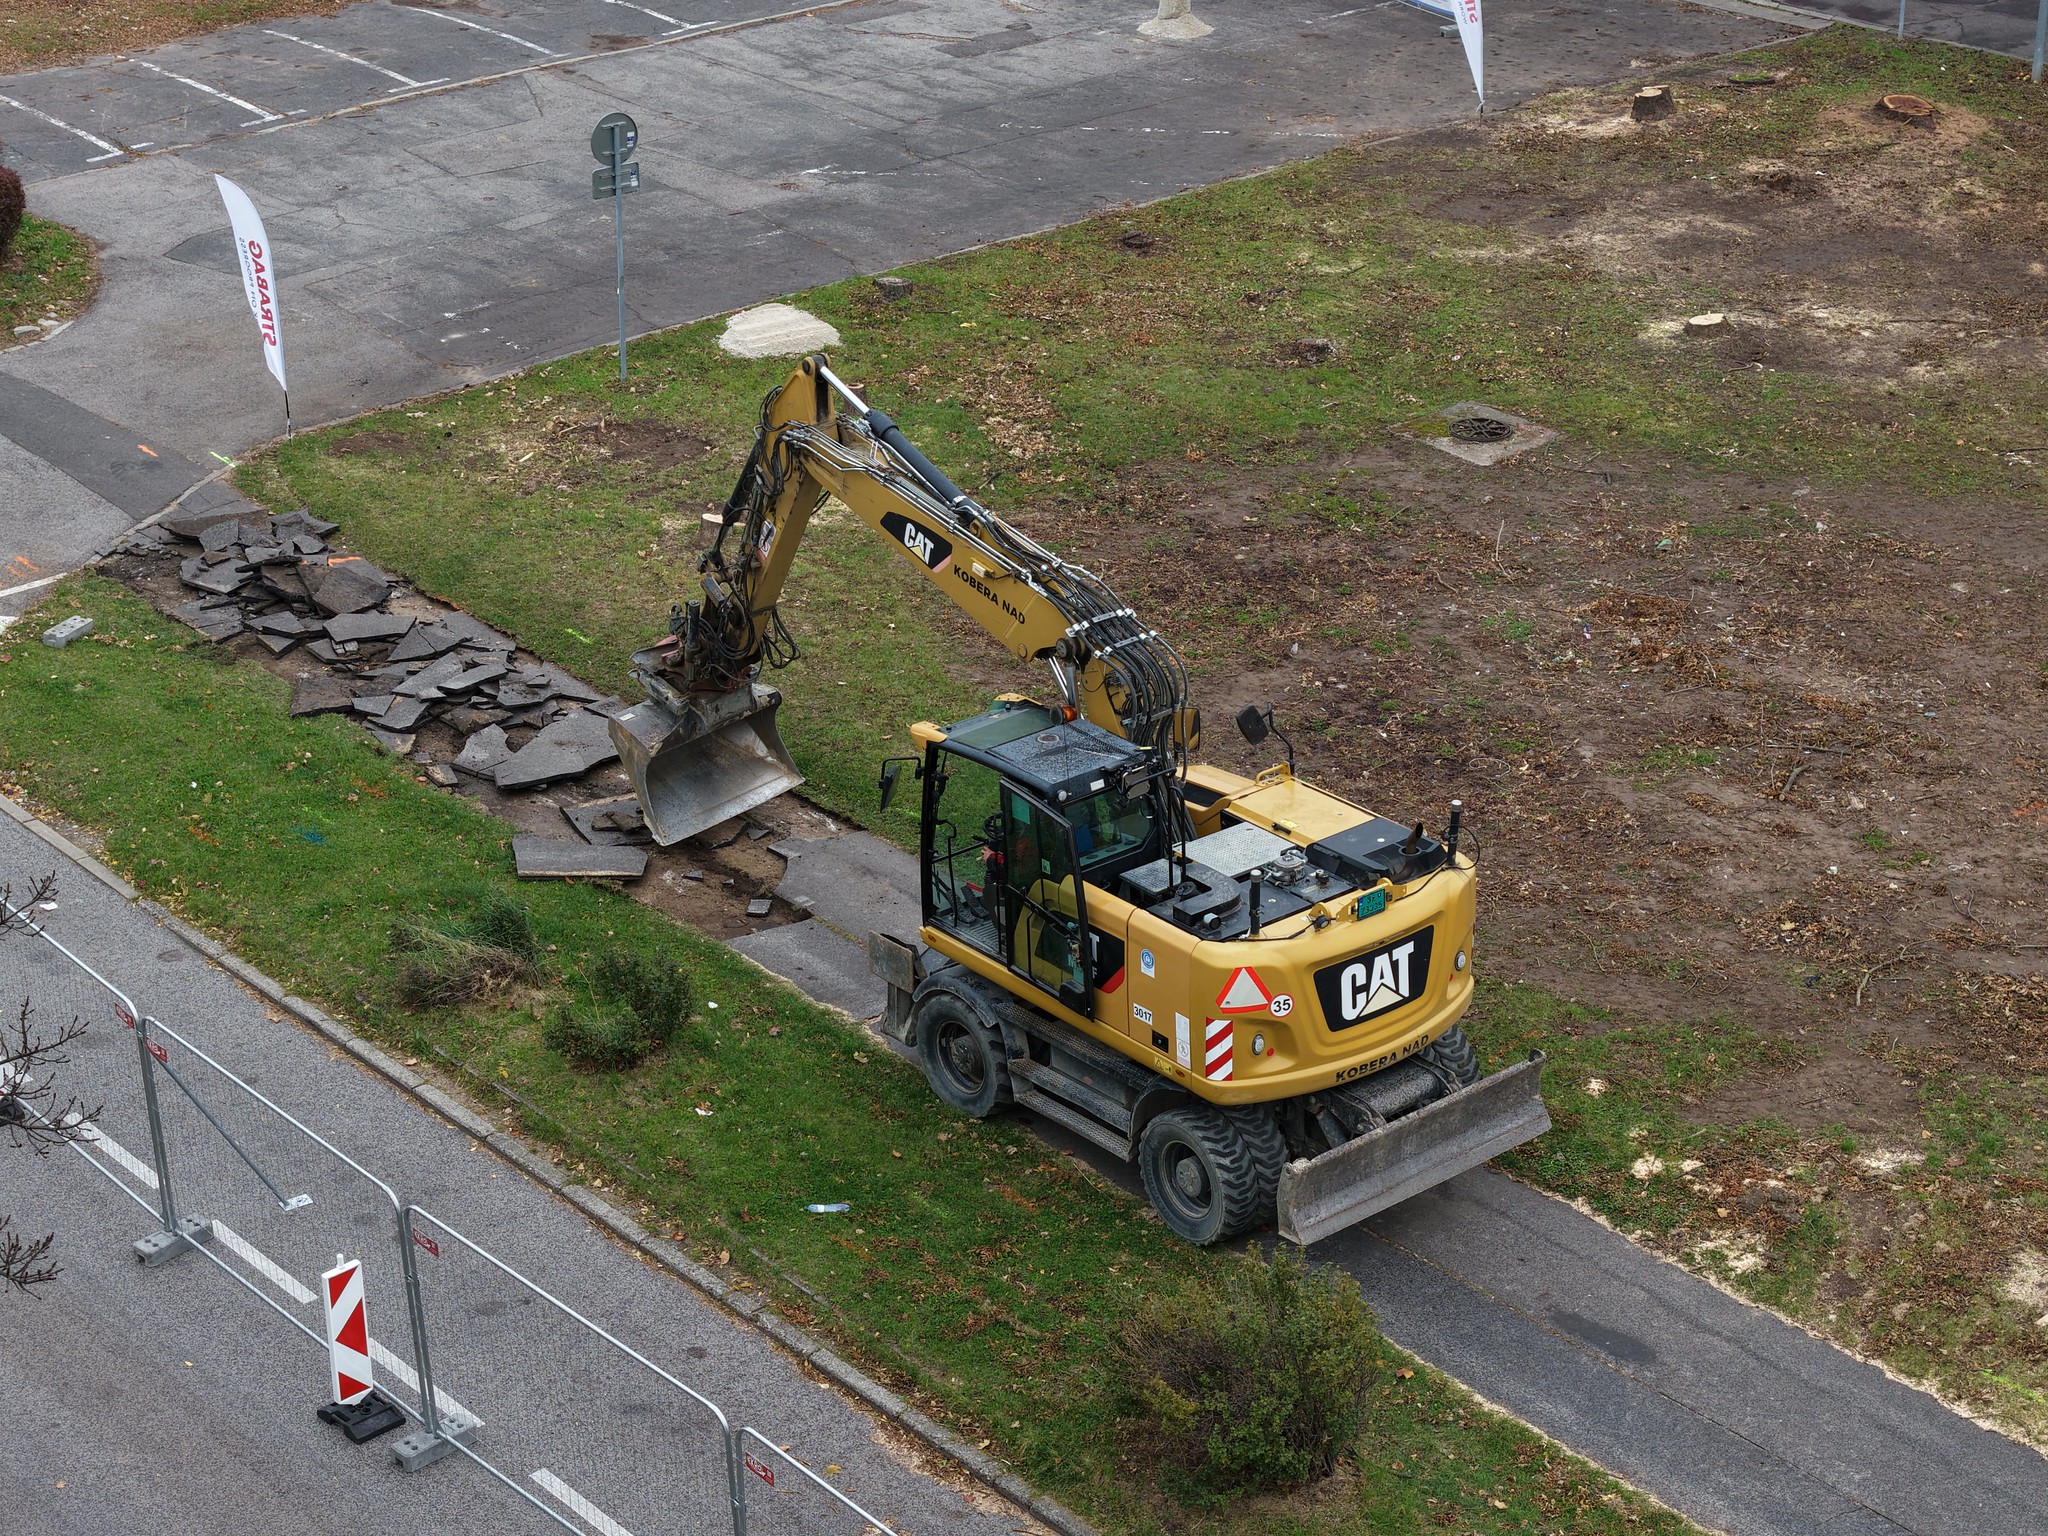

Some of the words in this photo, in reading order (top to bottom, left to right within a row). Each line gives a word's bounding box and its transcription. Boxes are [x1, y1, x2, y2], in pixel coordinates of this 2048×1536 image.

[904, 522, 934, 564] CAT
[953, 564, 999, 606] KOBERA
[1002, 600, 1026, 625] NAD
[1340, 940, 1415, 1021] CAT
[1134, 1006, 1152, 1022] 3017
[1273, 998, 1291, 1013] 35
[1335, 1051, 1398, 1083] KOBERA
[1402, 1034, 1429, 1056] NAD
